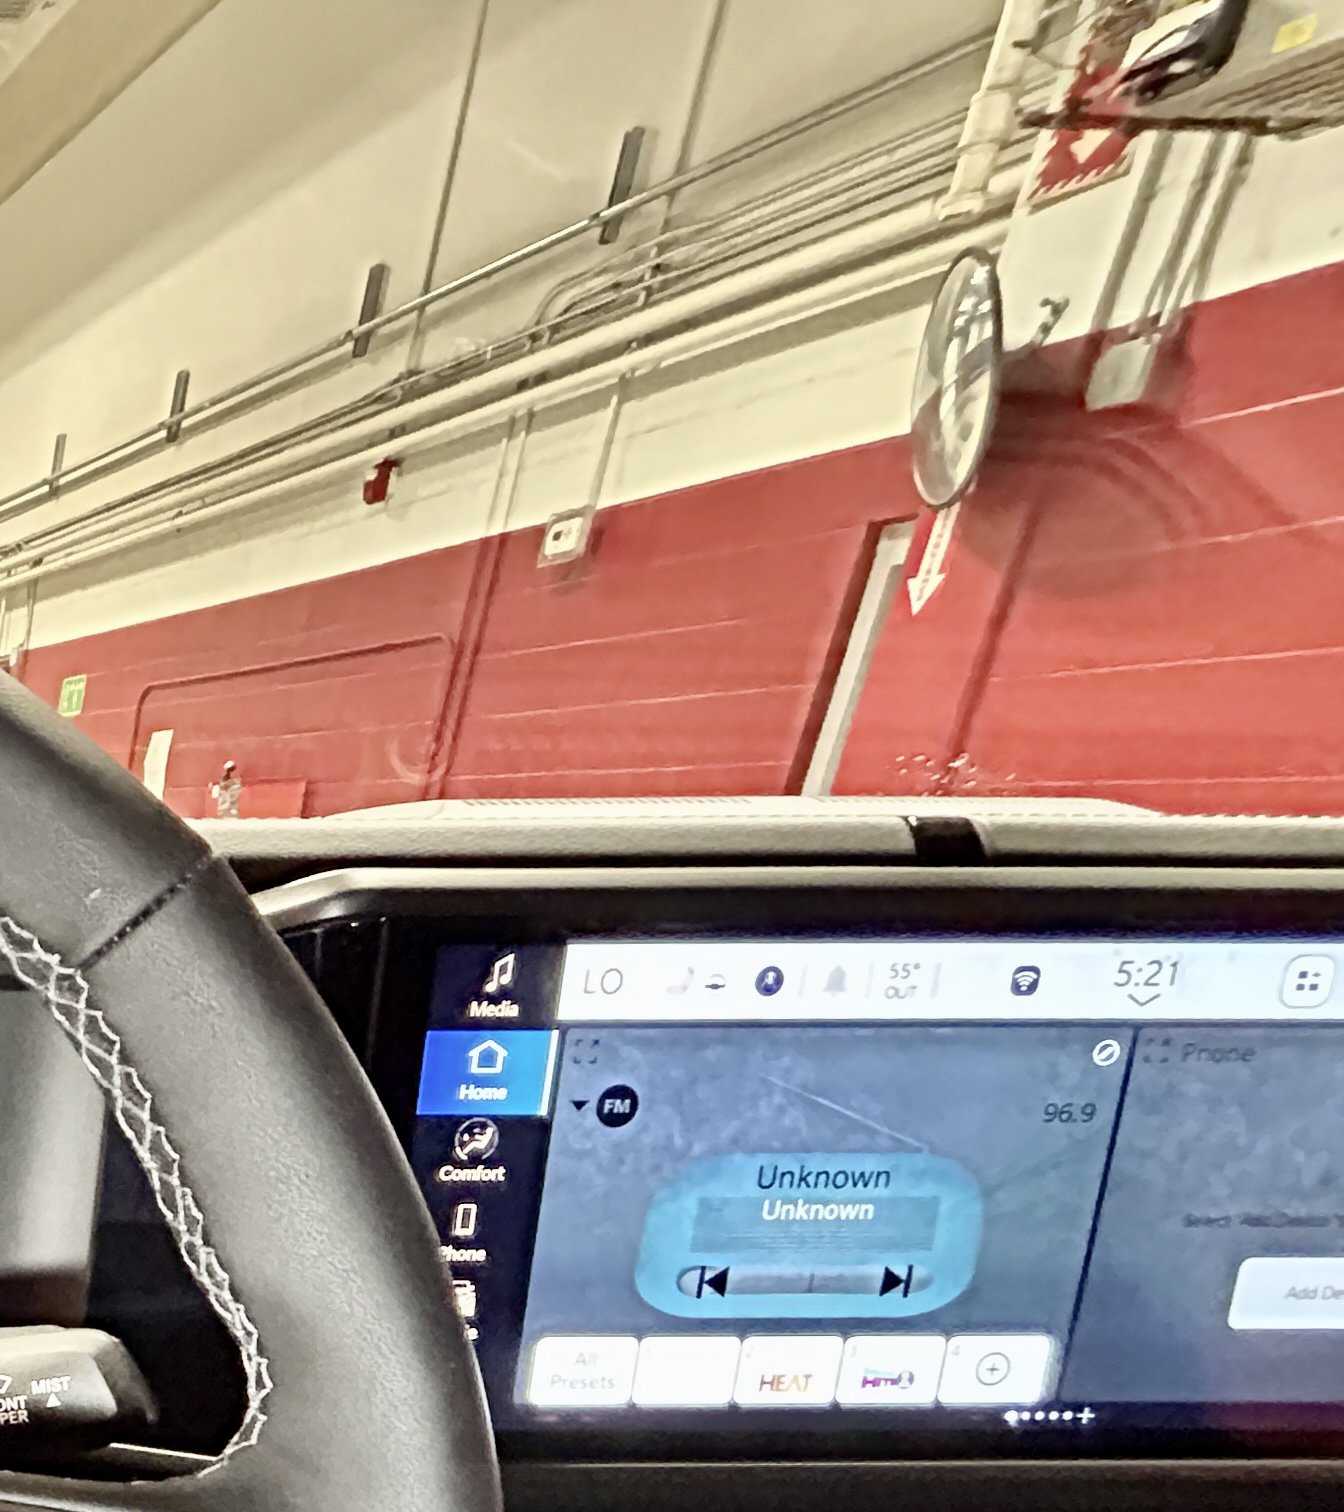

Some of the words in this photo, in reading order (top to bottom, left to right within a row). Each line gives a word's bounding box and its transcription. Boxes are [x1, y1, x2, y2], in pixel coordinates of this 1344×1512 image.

[584, 967, 623, 995] LO
[889, 962, 920, 981] 55°
[1114, 959, 1179, 988] 5:21
[469, 999, 519, 1018] Media
[458, 1083, 508, 1102] Home
[603, 1098, 632, 1115] FM
[1043, 1101, 1097, 1125] 96.9
[438, 1165, 506, 1184] Comfort
[757, 1165, 891, 1191] Unknown
[761, 1199, 874, 1221] Unknown
[1284, 1286, 1318, 1300] Add
[574, 1352, 598, 1366] All
[30, 1375, 71, 1395] MIST
[550, 1373, 615, 1390] Presets
[759, 1374, 813, 1393] HEAT
